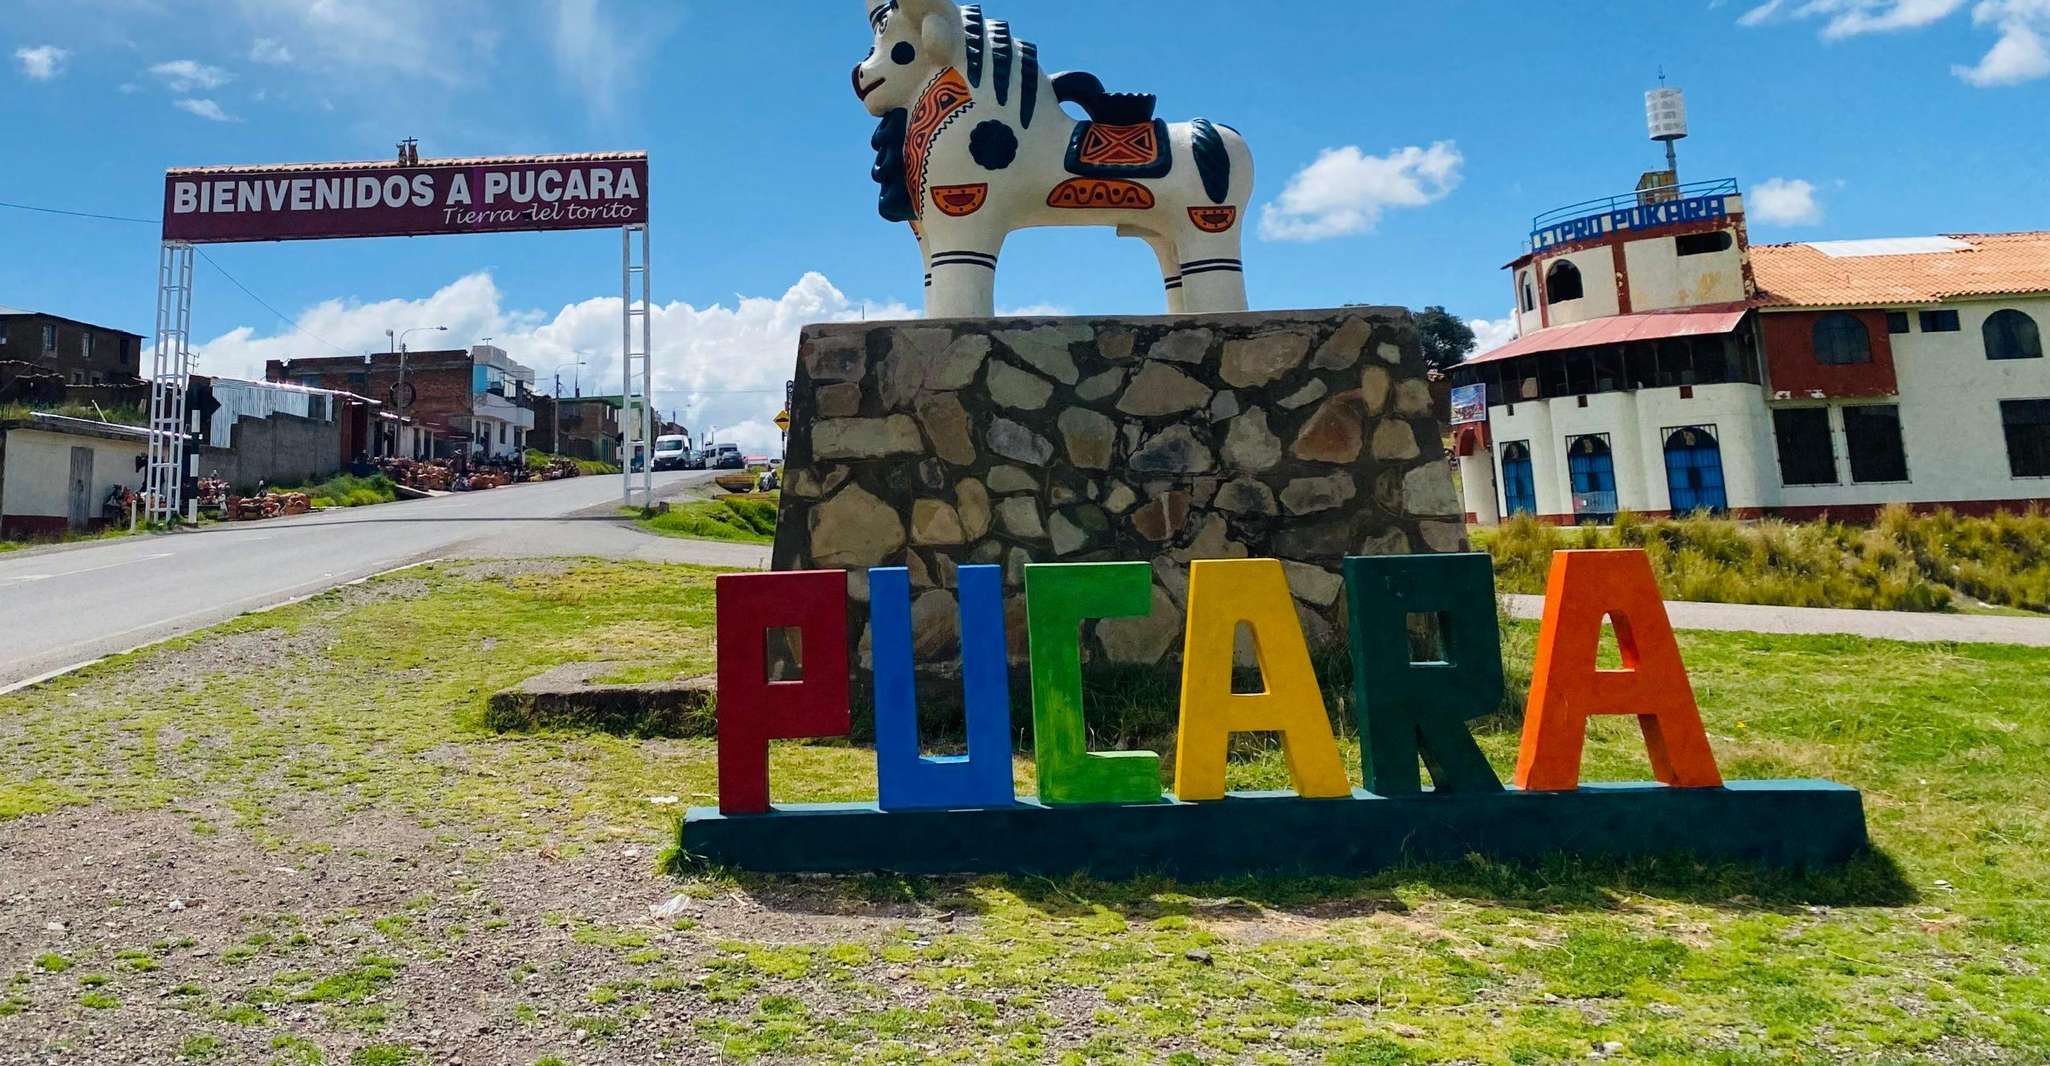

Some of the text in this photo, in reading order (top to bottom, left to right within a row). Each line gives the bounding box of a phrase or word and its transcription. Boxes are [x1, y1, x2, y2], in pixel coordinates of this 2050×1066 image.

[173, 167, 640, 214] BIENVENIDOS A PUCARA
[443, 206, 521, 225] Tierra
[567, 201, 638, 219] torito
[1611, 195, 1725, 235] PUKARA
[715, 548, 1724, 814] PUCARA
